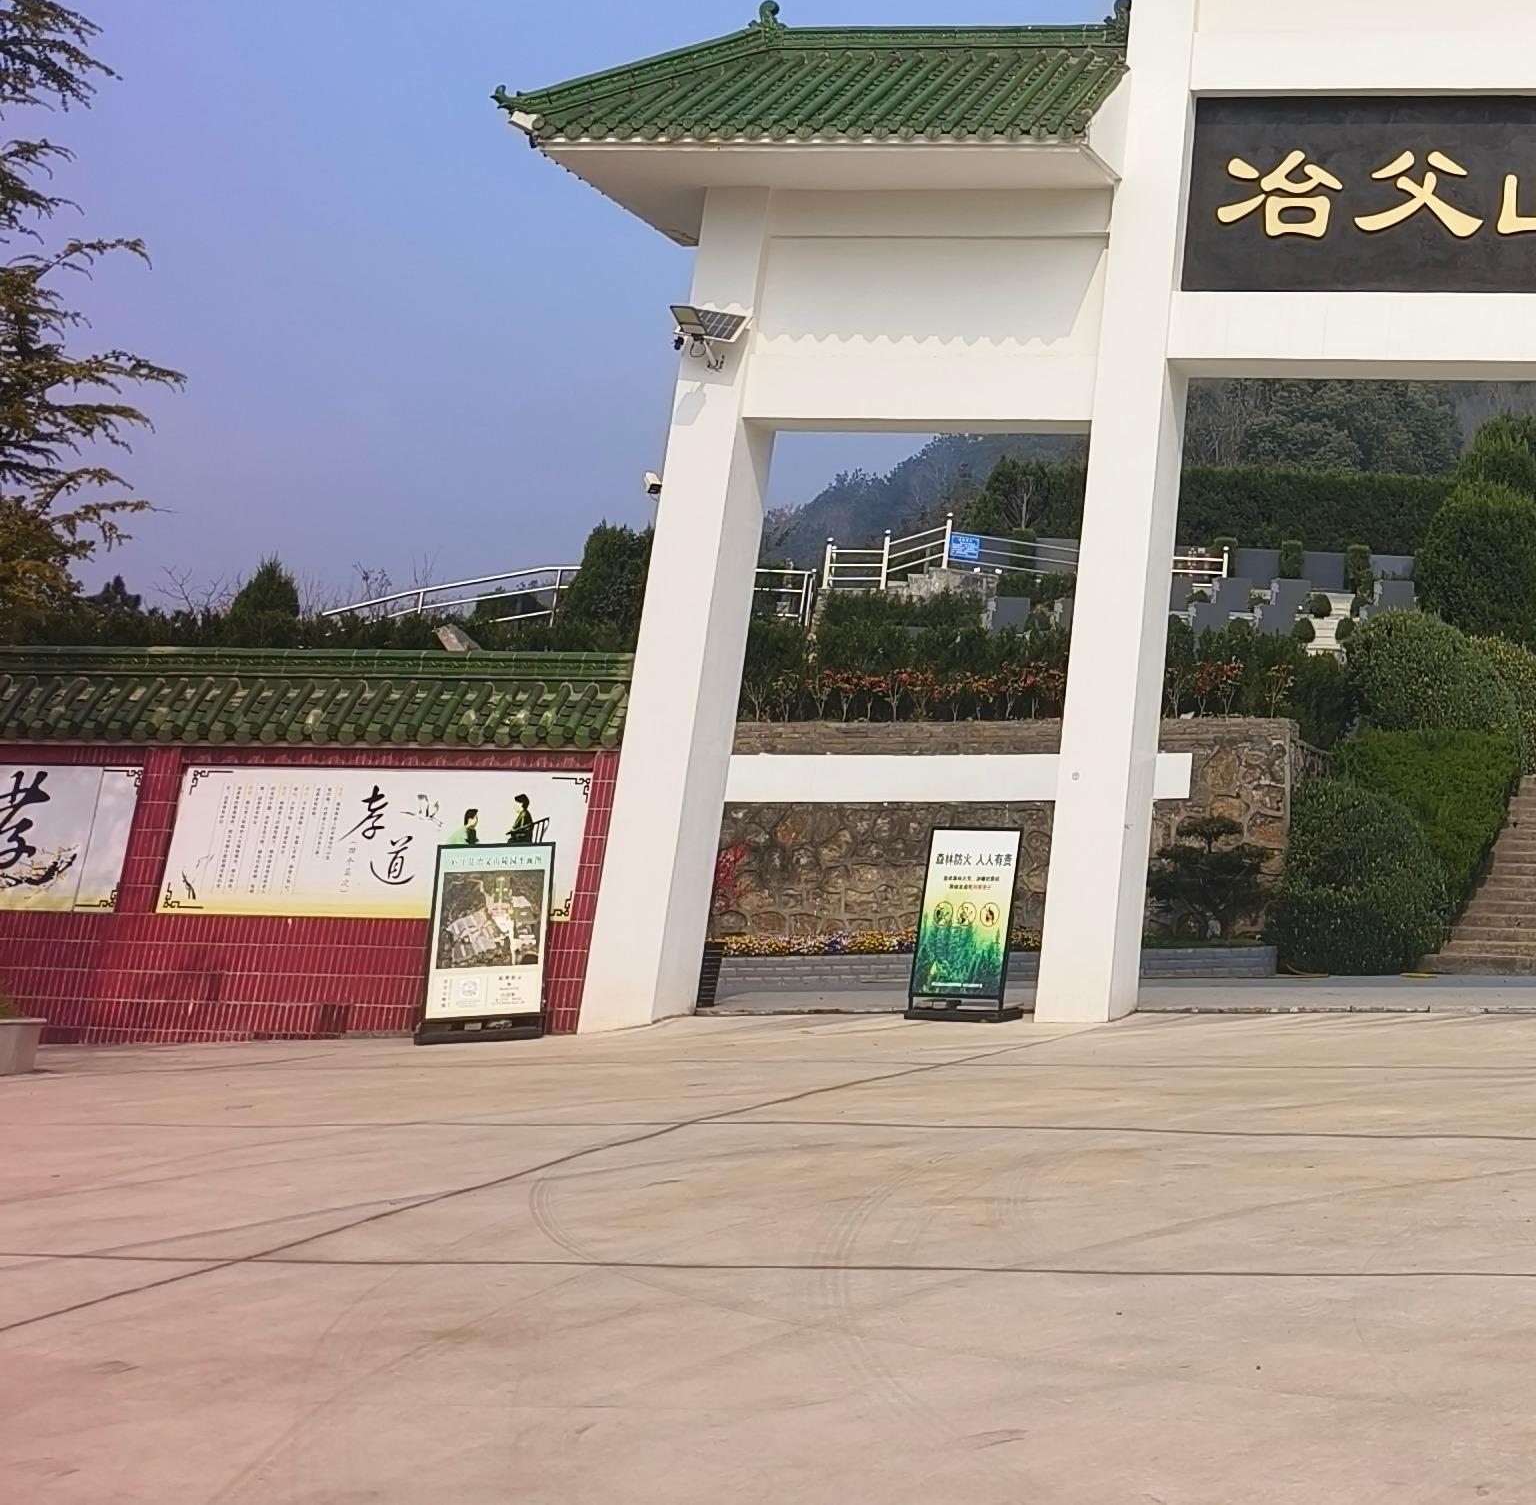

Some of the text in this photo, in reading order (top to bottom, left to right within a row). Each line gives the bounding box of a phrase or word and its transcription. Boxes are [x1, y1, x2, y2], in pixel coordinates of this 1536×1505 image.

[935, 853, 1013, 867] 森林防火 人人有责
